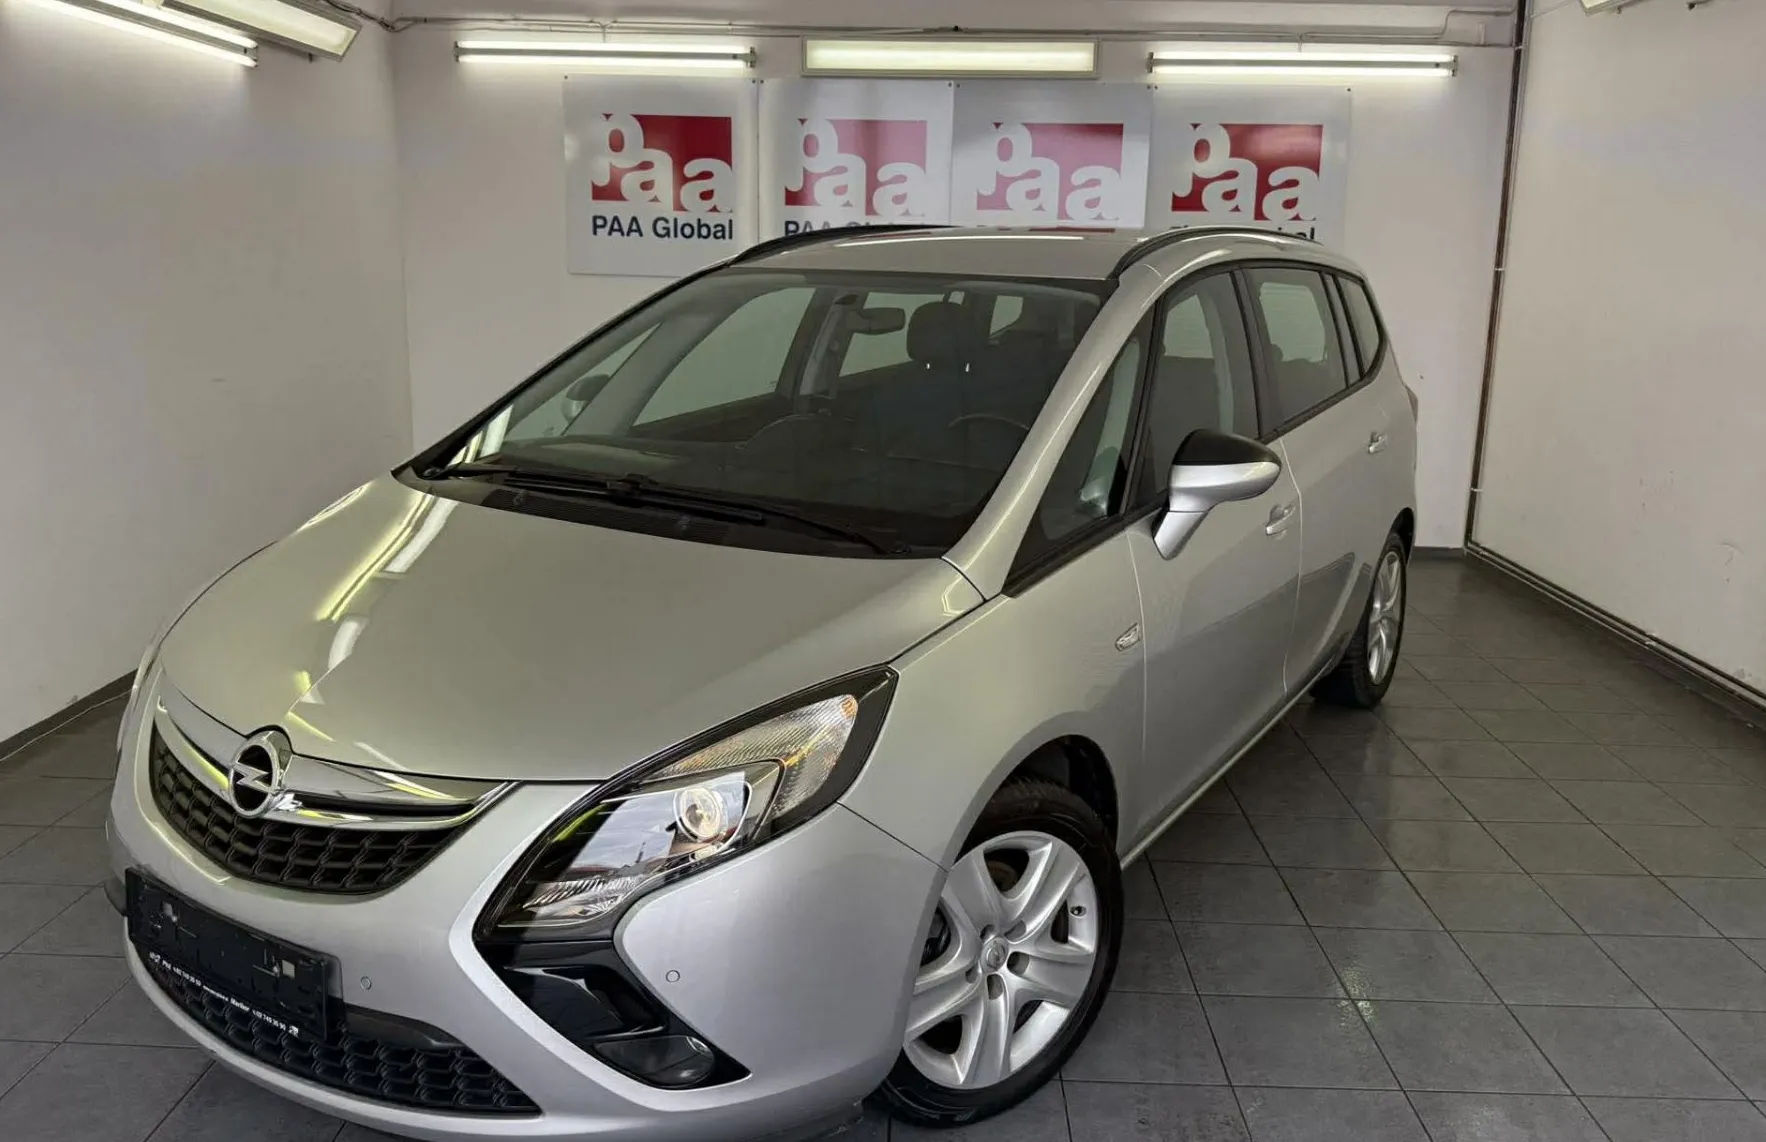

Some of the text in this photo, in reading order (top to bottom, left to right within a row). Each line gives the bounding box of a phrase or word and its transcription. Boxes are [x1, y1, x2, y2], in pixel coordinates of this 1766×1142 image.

[590, 113, 733, 213] paa
[785, 118, 926, 217] paa
[976, 122, 1121, 220] paa
[1171, 123, 1318, 221] paa
[592, 215, 733, 240] PAA Global
